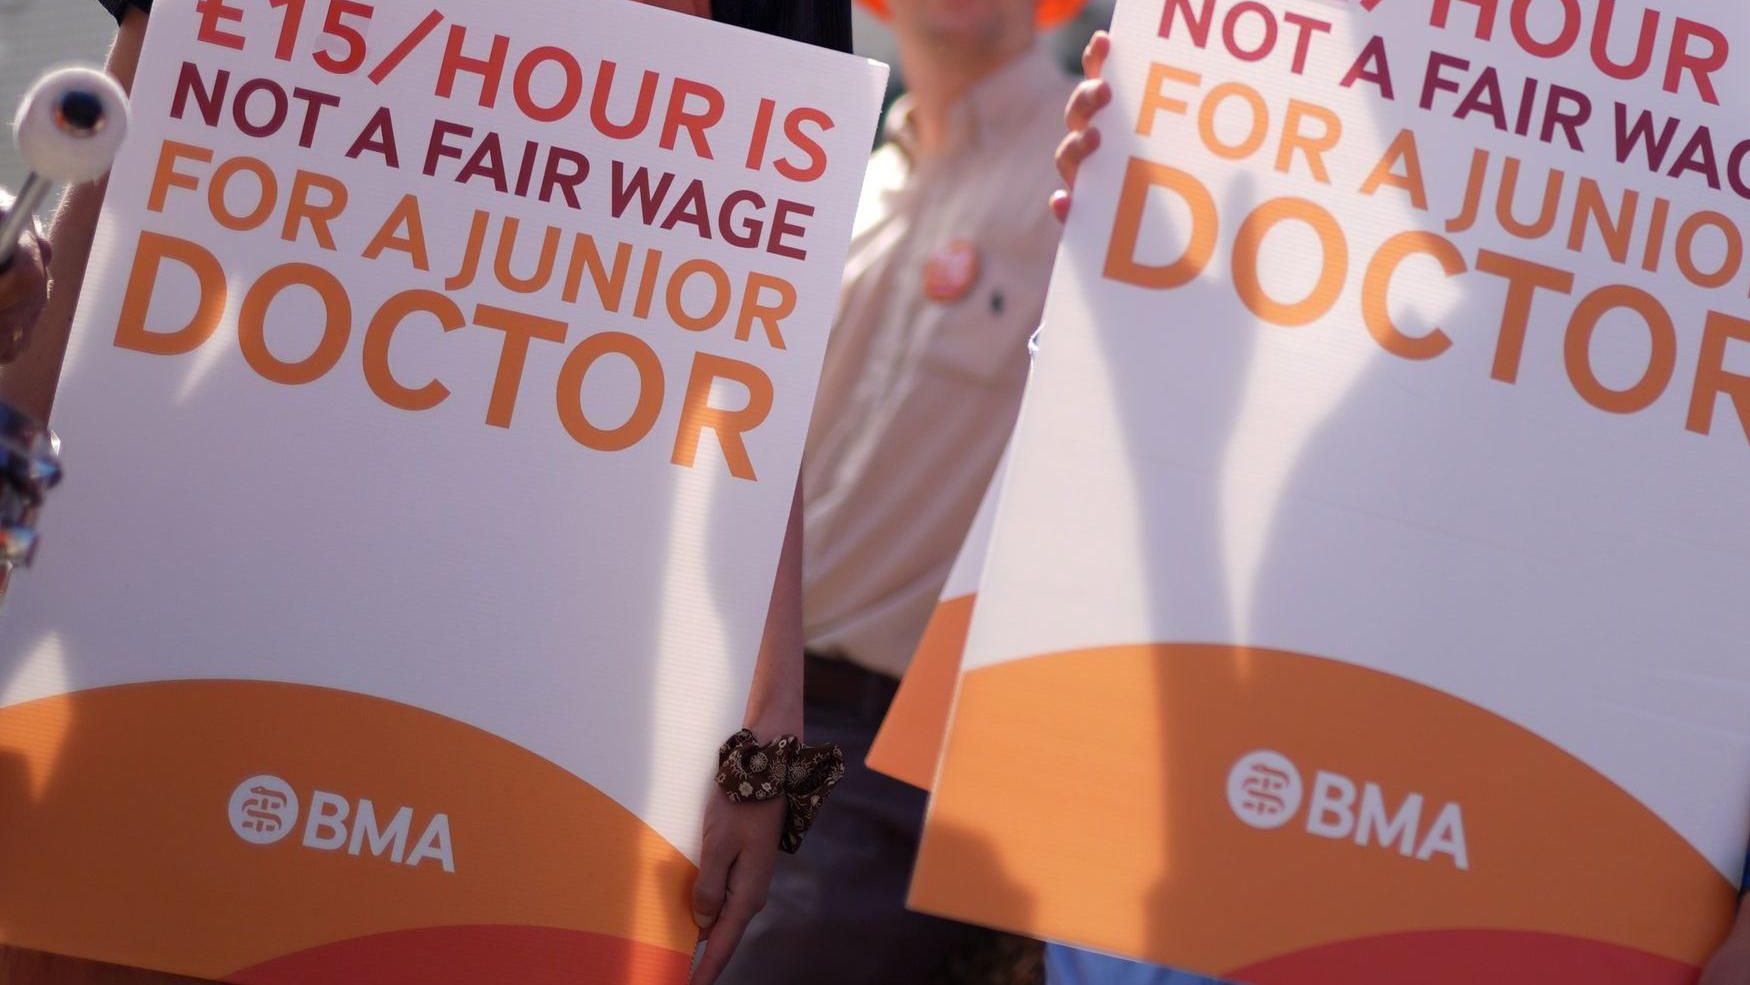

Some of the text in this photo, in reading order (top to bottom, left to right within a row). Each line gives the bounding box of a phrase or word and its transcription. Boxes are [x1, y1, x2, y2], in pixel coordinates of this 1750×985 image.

[747, 98, 834, 182] IS
[1136, 63, 1341, 184] FOR
[1361, 128, 1428, 211] A
[1340, 36, 1393, 100] A
[1419, 56, 1591, 151] FAIR
[170, 61, 814, 260] NOT A FAIR WAGE
[147, 139, 797, 350] FOR A JUNIOR
[114, 230, 773, 482] DOCTOR
[303, 790, 455, 873] BMA
[1306, 770, 1469, 871] BMA
